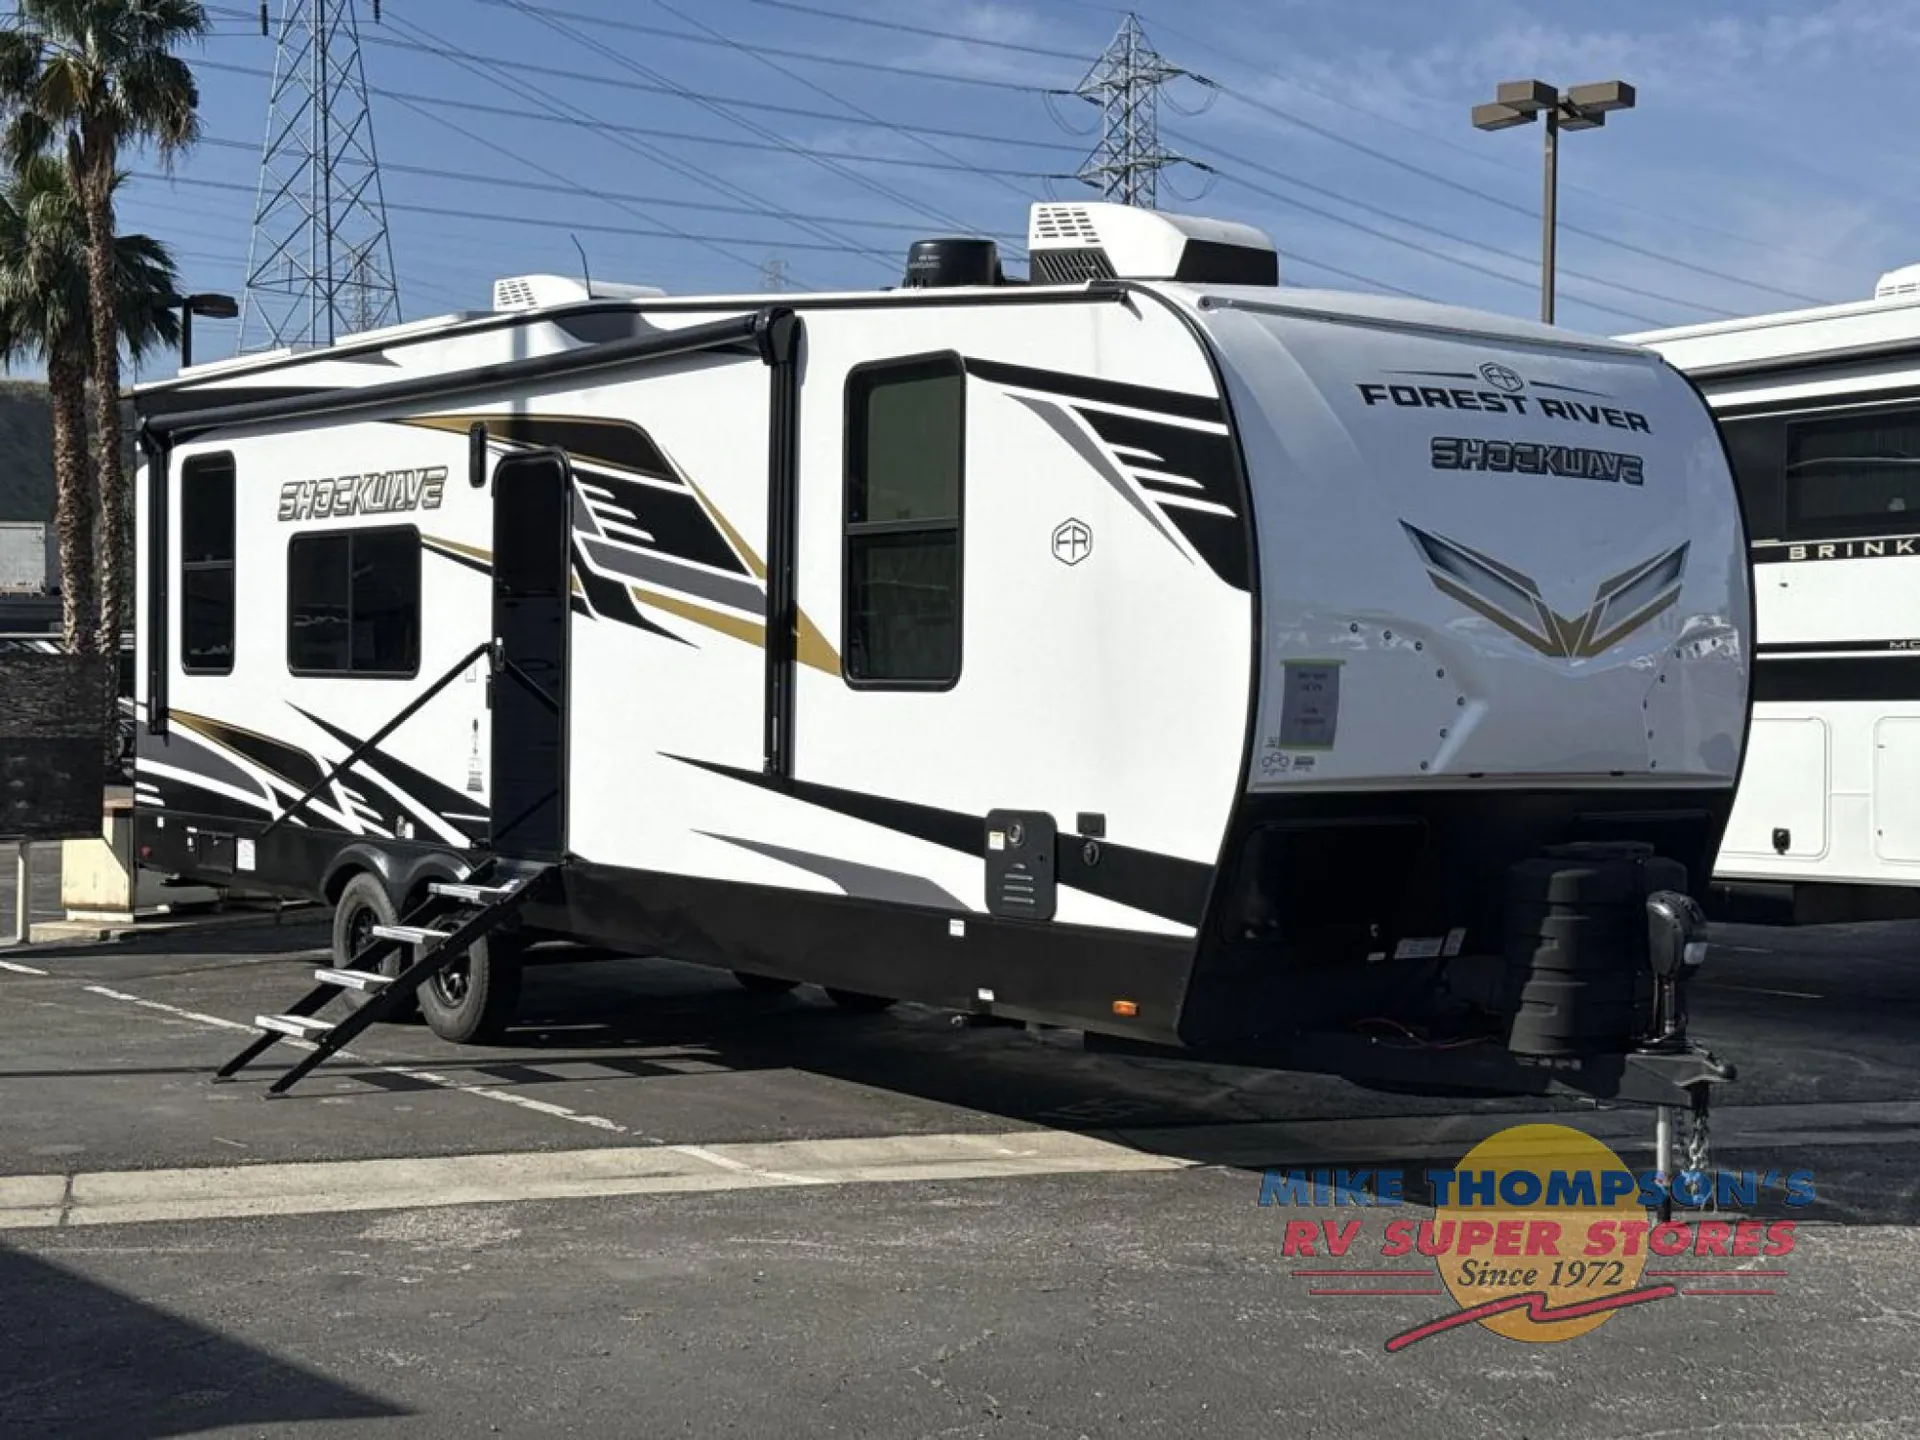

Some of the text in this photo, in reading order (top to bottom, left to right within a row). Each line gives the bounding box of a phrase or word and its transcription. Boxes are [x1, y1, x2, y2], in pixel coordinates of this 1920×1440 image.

[1356, 383, 1653, 435] FOREST RIVER
[1429, 436, 1645, 487] SHOCKWAVE
[276, 464, 449, 522] SHOCKWAVE
[1788, 539, 1916, 561] BRINK
